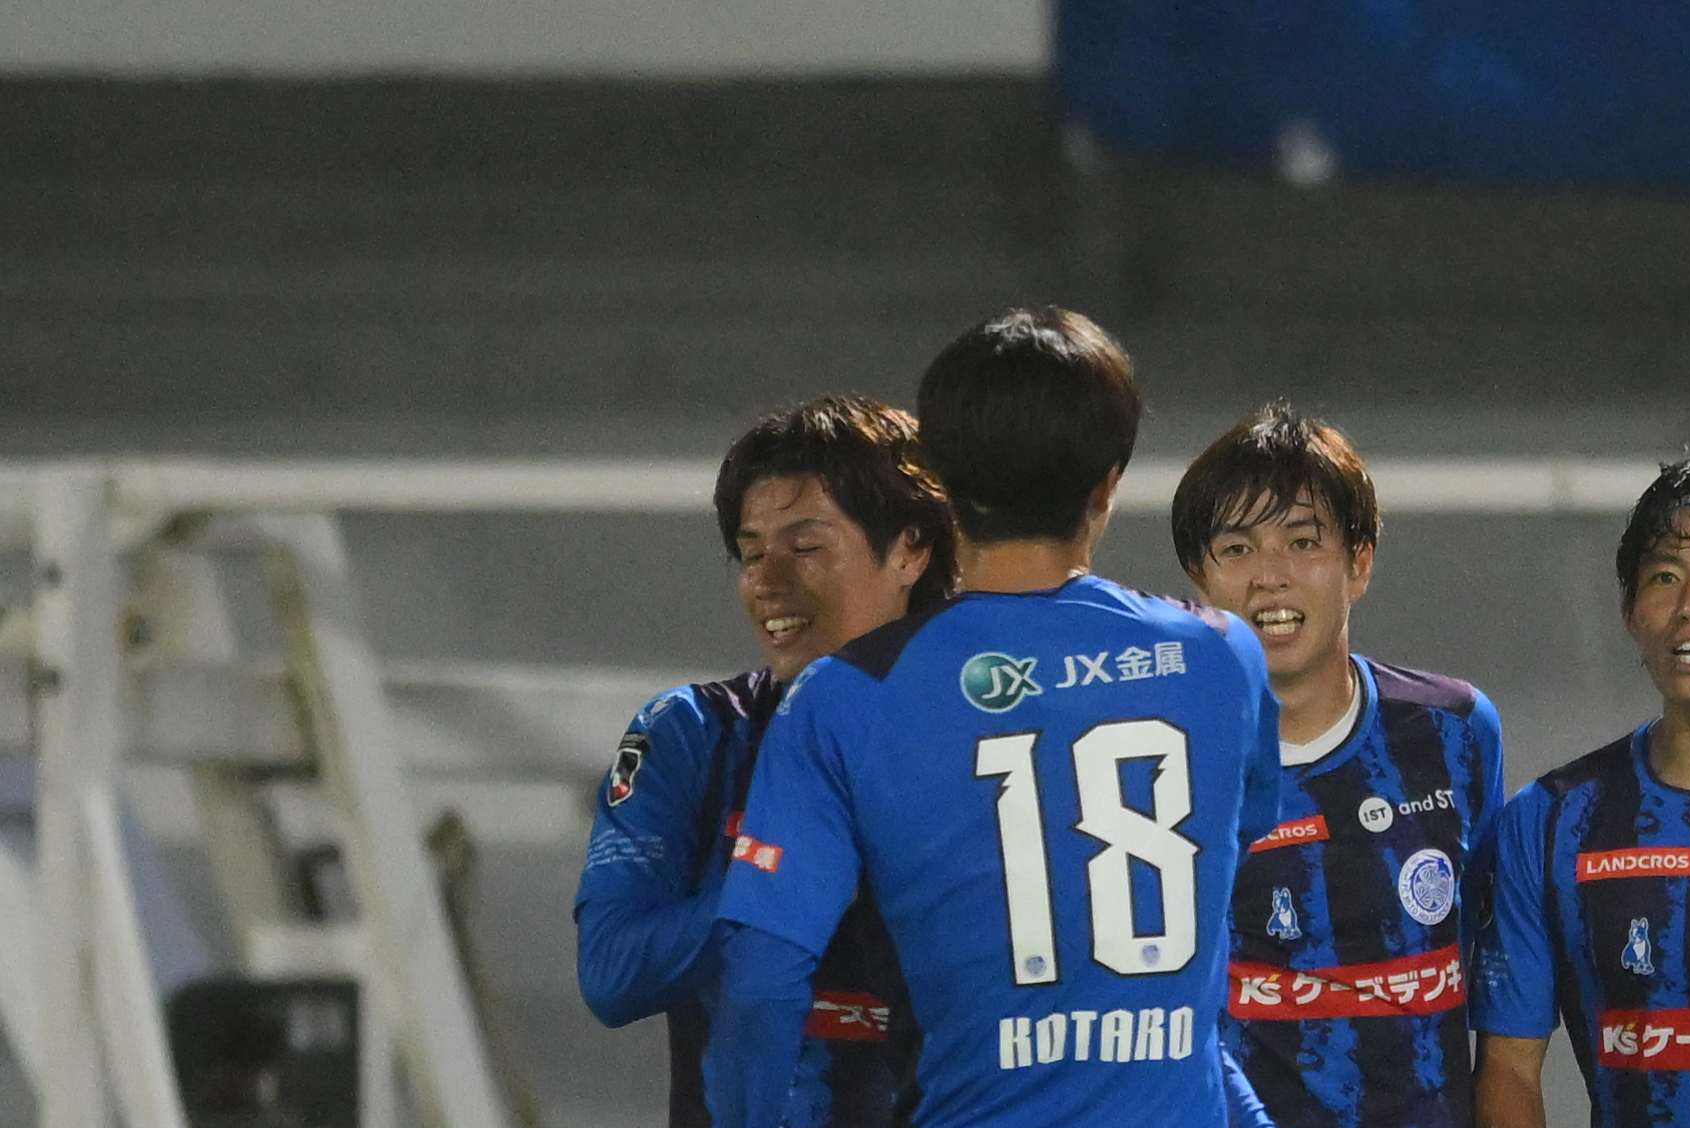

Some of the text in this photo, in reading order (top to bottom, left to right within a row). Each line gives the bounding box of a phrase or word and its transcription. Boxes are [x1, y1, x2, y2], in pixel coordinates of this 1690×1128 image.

[1056, 641, 1187, 688] JX金属
[1399, 795, 1434, 815] and
[1435, 789, 1455, 810] ST
[1254, 824, 1318, 844] CROS
[975, 719, 1201, 986] 18
[1587, 855, 1689, 875] LANDCROS
[1000, 1006, 1194, 1069] KOTARO
